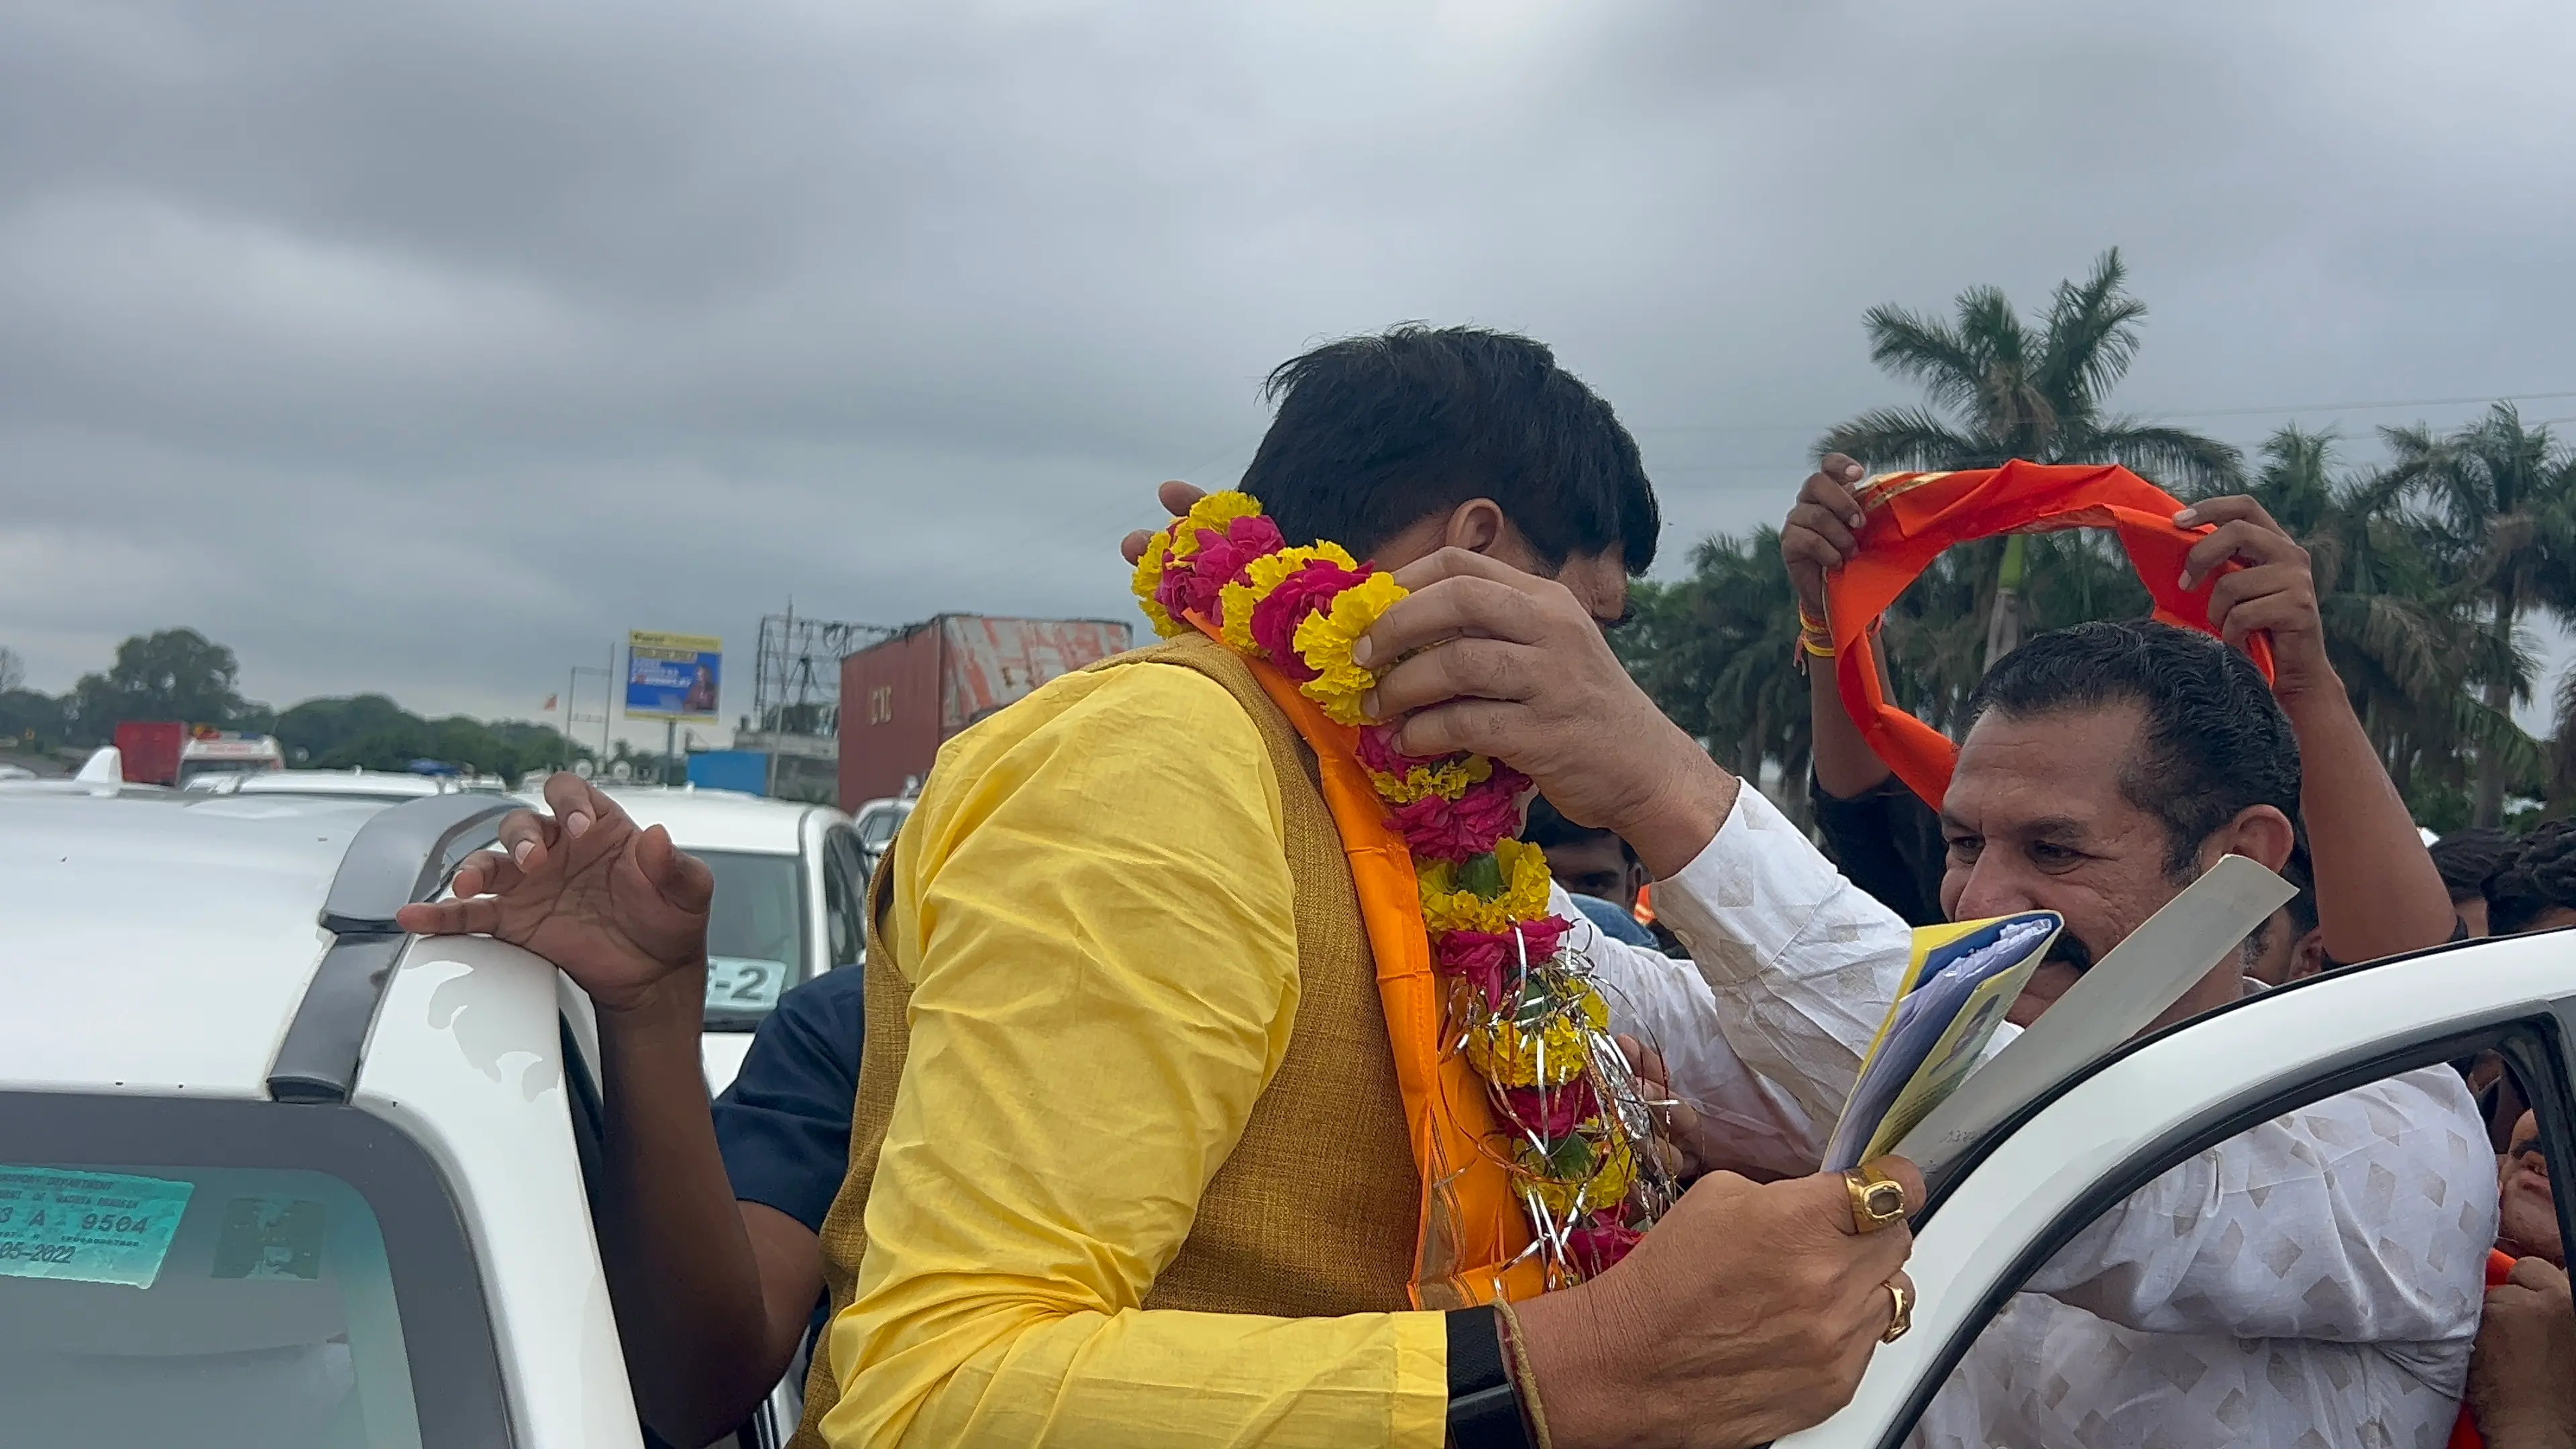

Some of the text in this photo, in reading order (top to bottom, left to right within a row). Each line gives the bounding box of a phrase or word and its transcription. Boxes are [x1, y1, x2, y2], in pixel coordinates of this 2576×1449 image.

[708, 963, 769, 1001] -2
[28, 1210, 46, 1226] A
[81, 1212, 148, 1234] 9504
